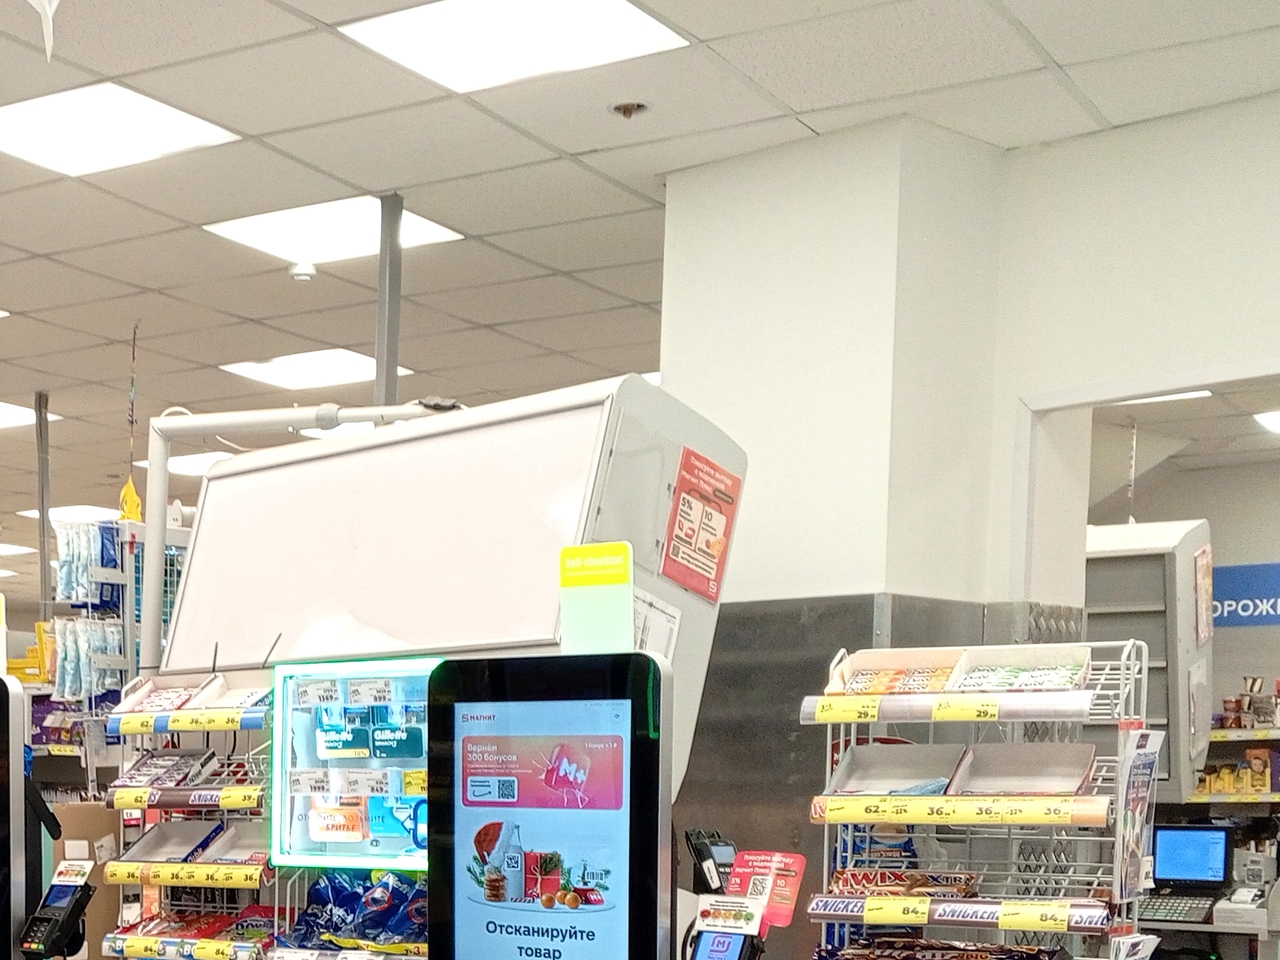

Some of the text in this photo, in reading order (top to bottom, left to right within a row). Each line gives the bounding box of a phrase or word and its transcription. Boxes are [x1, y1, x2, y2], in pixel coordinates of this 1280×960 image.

[470, 714, 496, 722] МАГНИТ
[374, 730, 407, 741] Gillette
[467, 743, 498, 753] Вернём
[467, 752, 517, 763] 300 бонусов
[776, 879, 786, 887] 10
[811, 898, 865, 914] SNICKER
[937, 903, 999, 919] SNICKER
[485, 920, 596, 943] Отсканируйте
